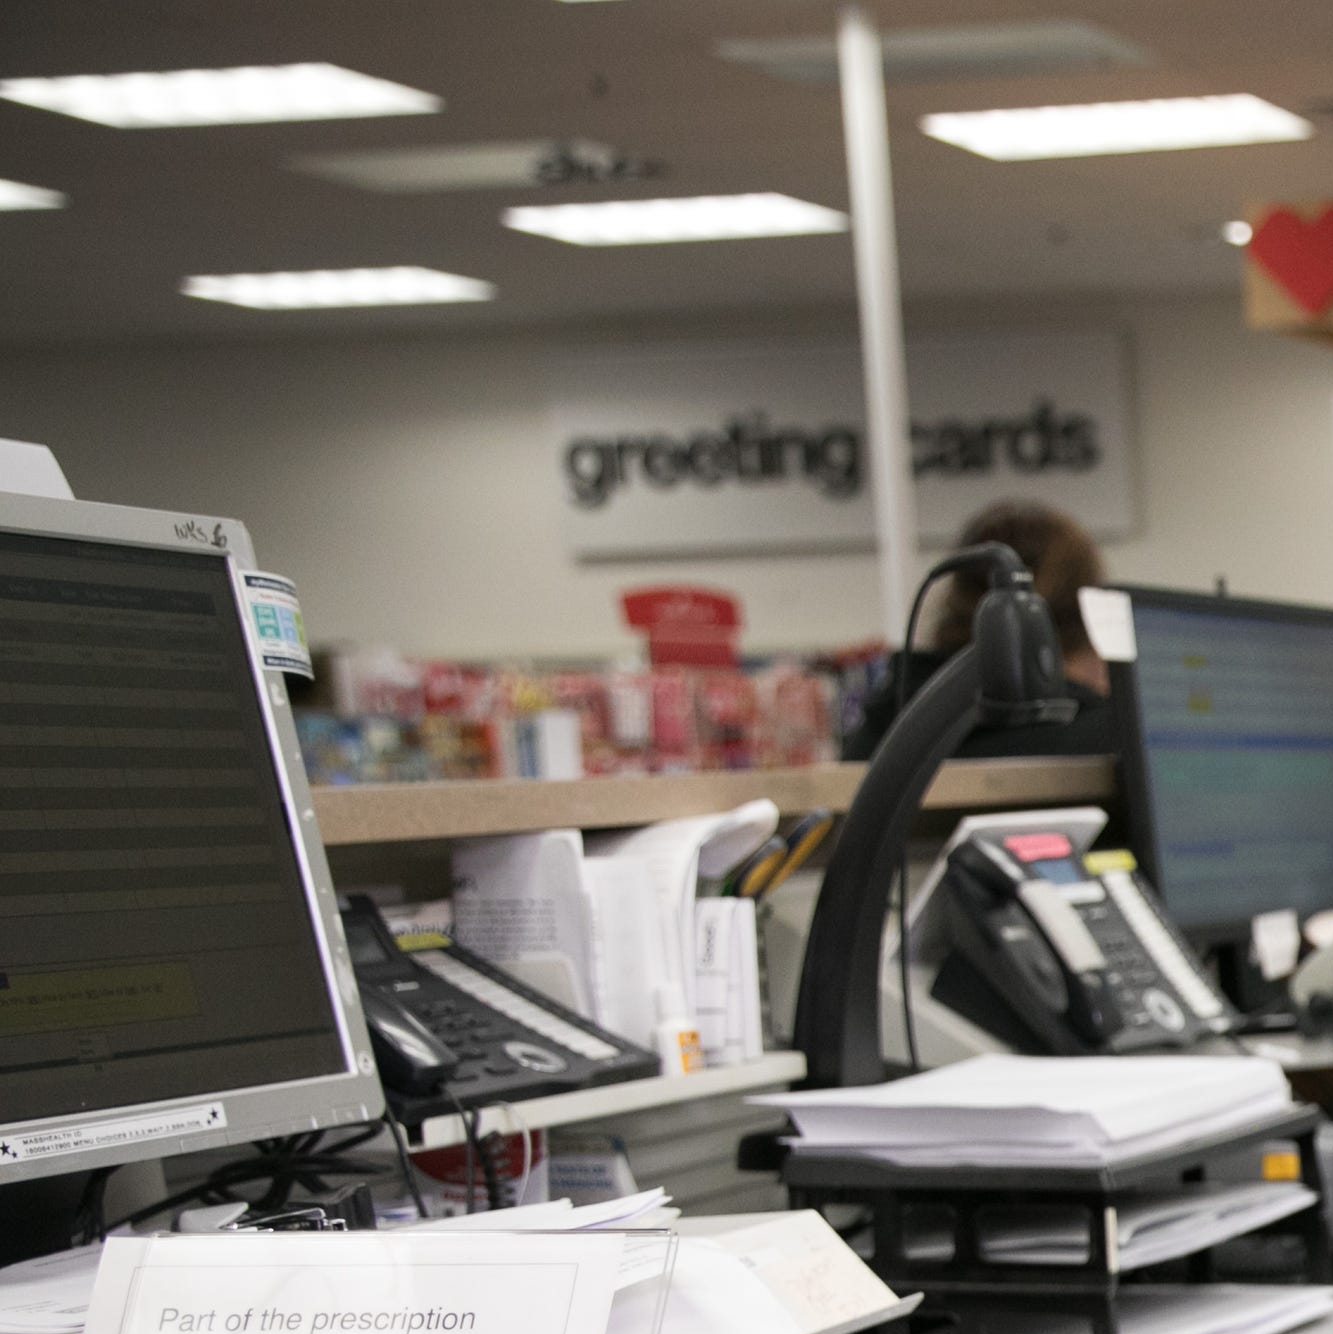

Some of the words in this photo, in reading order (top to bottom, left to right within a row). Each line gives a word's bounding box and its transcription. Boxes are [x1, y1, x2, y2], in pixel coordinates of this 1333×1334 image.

[562, 409, 865, 510] greeting
[158, 1308, 217, 1332] Part
[224, 1307, 255, 1332] of
[259, 1307, 302, 1331] the
